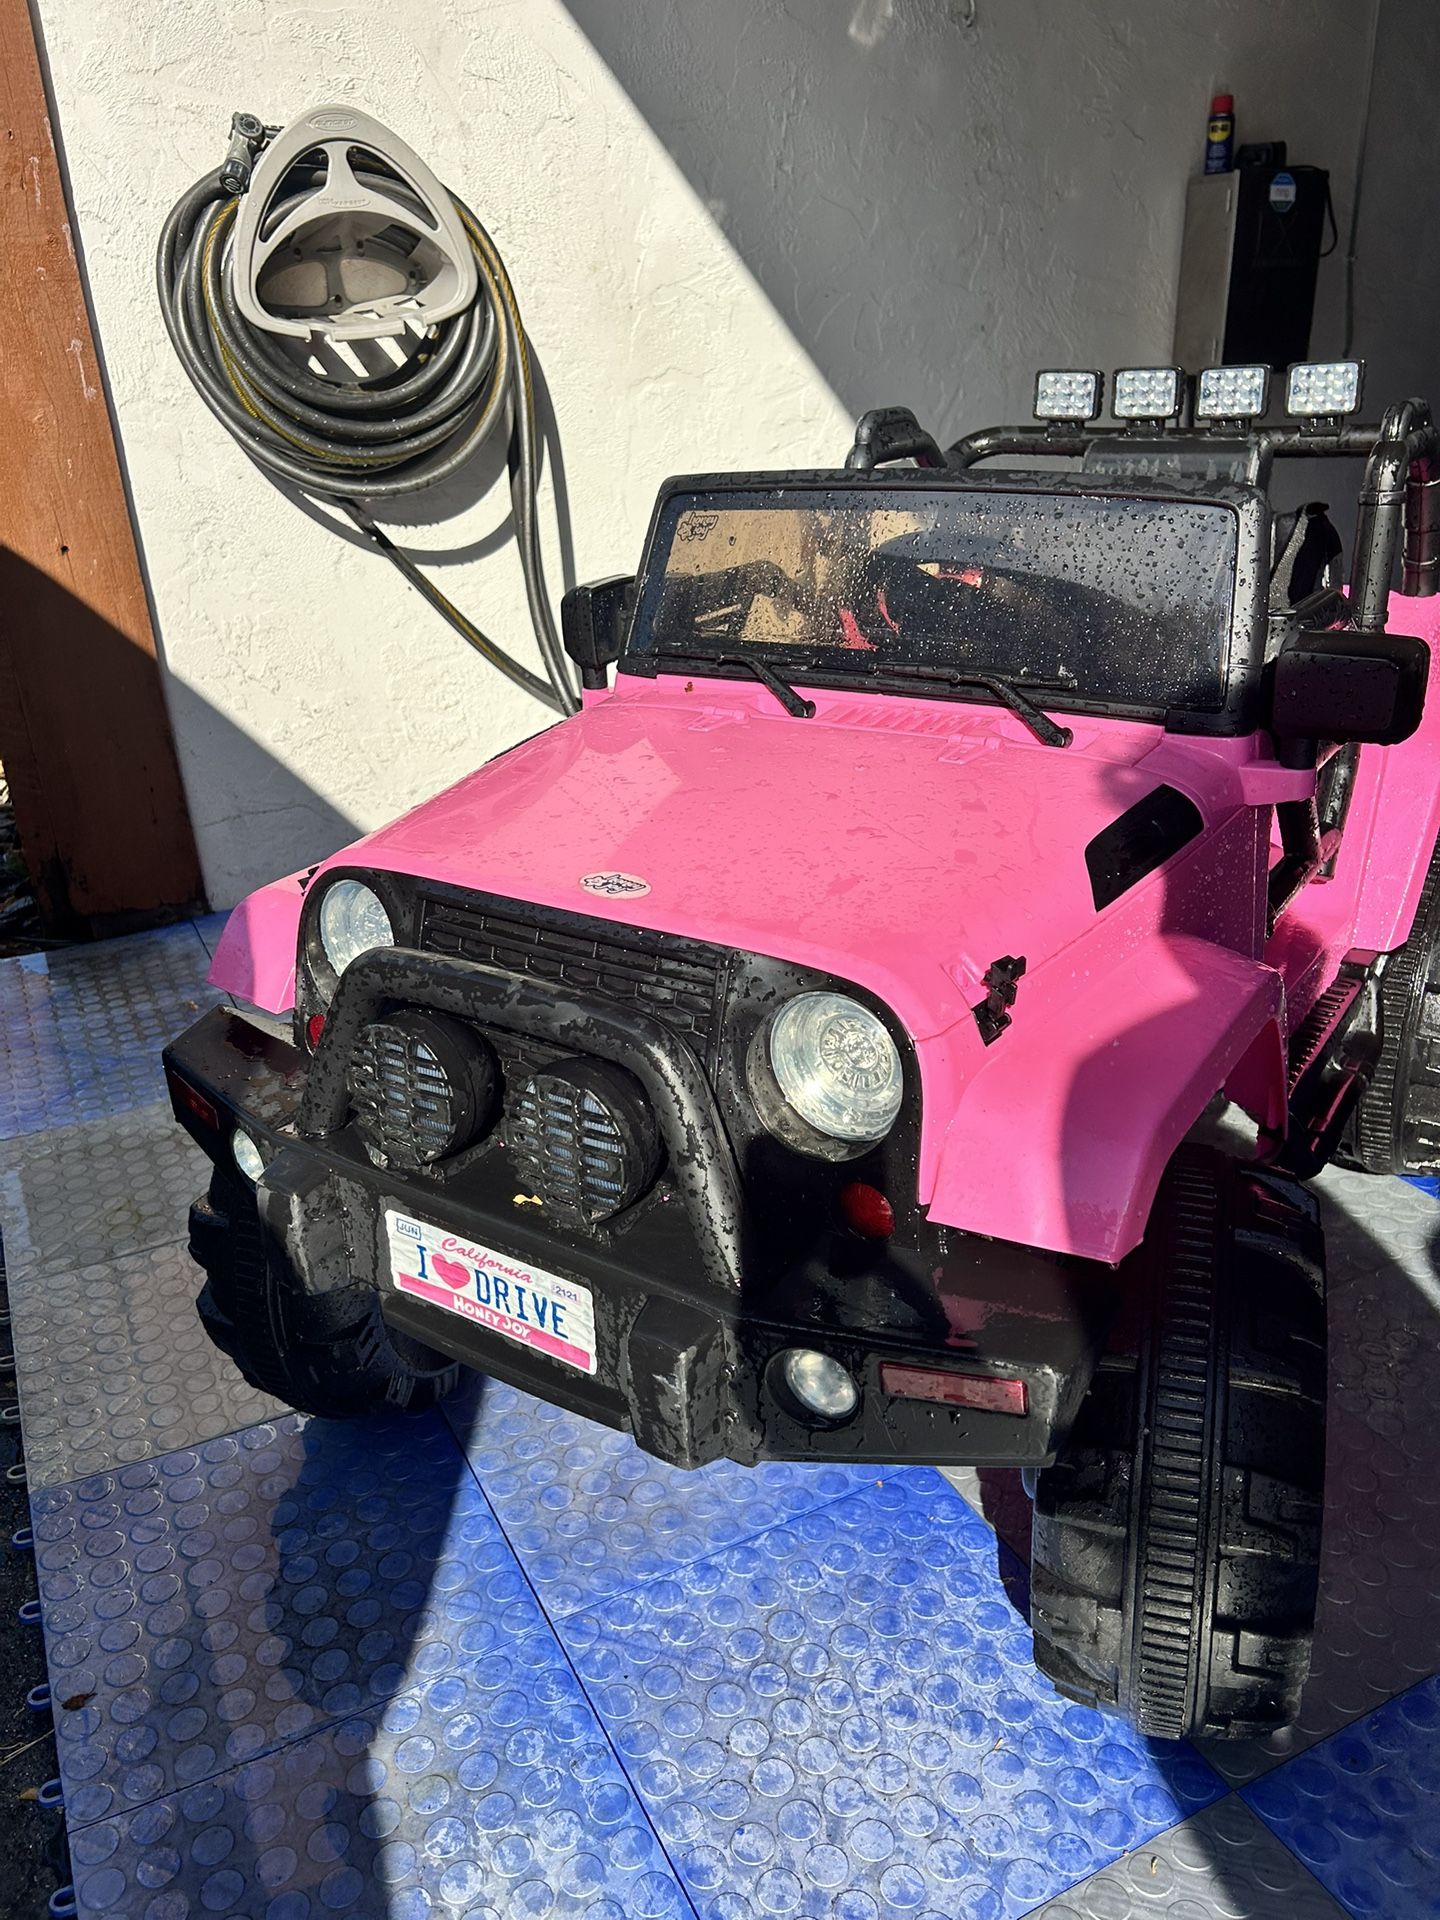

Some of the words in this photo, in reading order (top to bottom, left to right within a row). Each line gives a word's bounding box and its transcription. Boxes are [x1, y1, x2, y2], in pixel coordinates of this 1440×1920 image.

[400, 1223, 418, 1236] JUN
[442, 1237, 533, 1283] California
[416, 1244, 428, 1279] I
[474, 1269, 569, 1339] DRIVE
[555, 1285, 578, 1301] 2121
[452, 1296, 500, 1325] HONEY
[502, 1316, 531, 1338] JOY
